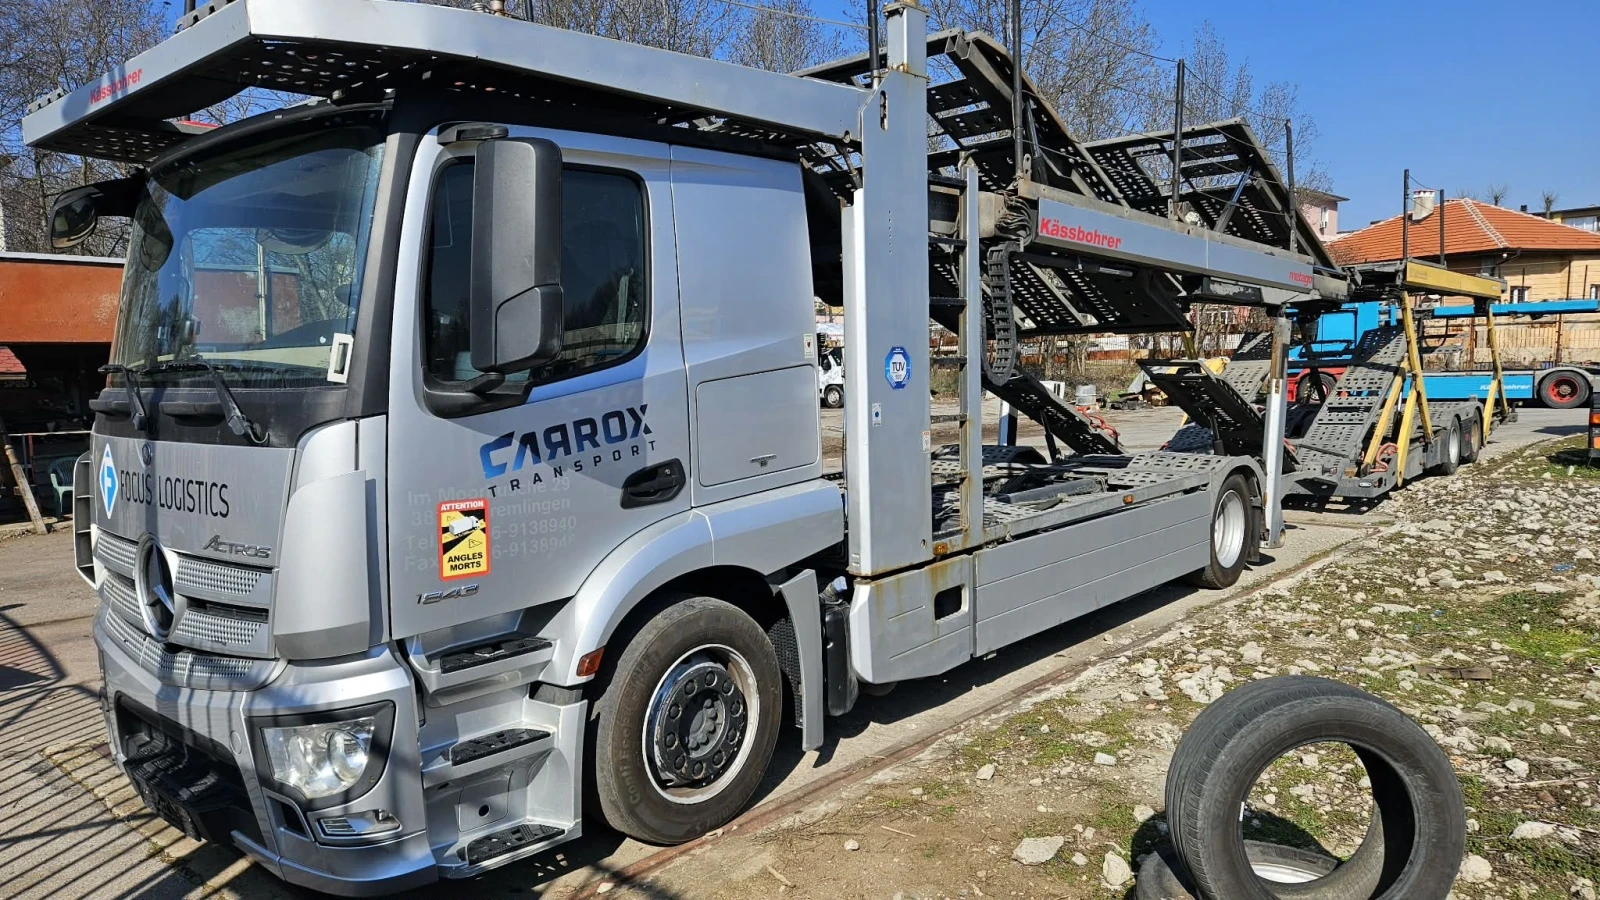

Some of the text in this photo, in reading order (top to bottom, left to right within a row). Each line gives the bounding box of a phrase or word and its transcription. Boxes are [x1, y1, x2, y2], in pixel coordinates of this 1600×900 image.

[90, 68, 143, 103] Kässbohrer
[1039, 218, 1122, 249] Kässbohrer
[479, 404, 653, 479] CARROX
[488, 440, 656, 498] TRANSPORT
[120, 470, 230, 519] FOCUS LOGISTICS
[408, 477, 570, 506] Im Moorusche 29
[441, 501, 484, 511] ATTENTION
[489, 498, 570, 517] remlingen
[491, 516, 577, 540] 6-9138940
[447, 552, 483, 563] ANGLES
[450, 561, 481, 571] MORTS
